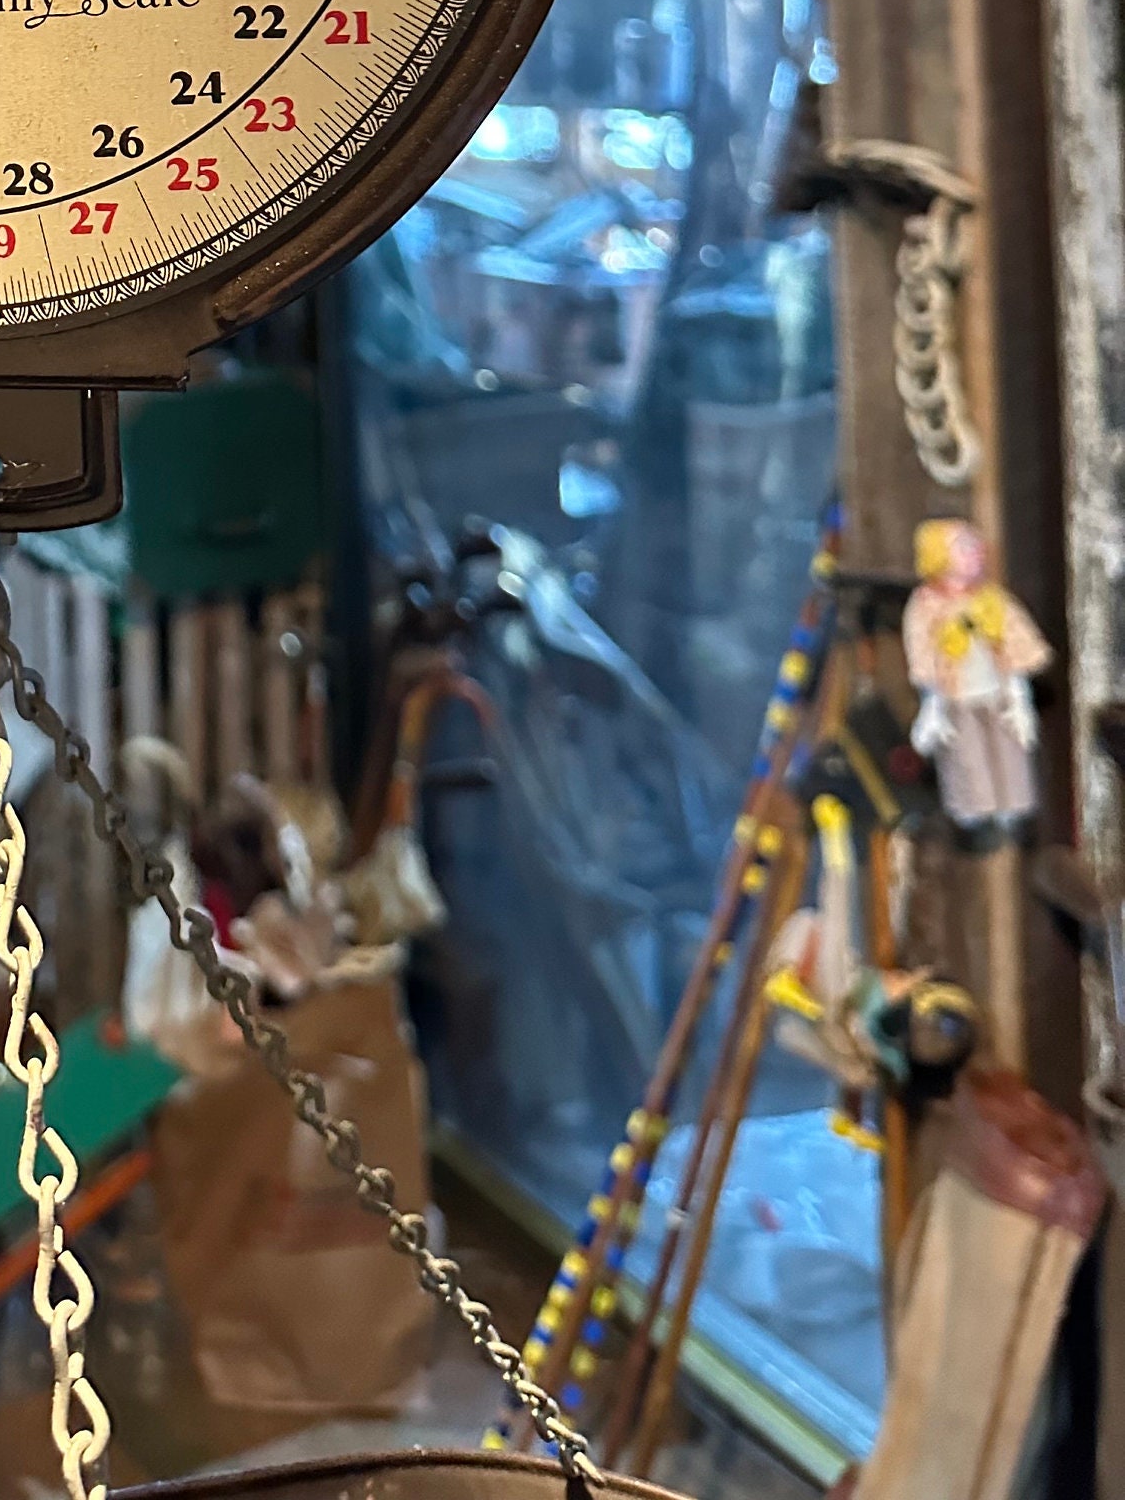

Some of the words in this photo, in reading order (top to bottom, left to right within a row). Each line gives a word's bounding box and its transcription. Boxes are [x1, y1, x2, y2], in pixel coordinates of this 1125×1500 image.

[234, 5, 287, 39] 22
[325, 10, 369, 44] 21
[170, 71, 226, 105] 24
[244, 96, 296, 132] 23
[92, 125, 143, 158] 26
[3, 162, 53, 195] 28
[167, 157, 220, 192] 25
[69, 201, 118, 235] 27
